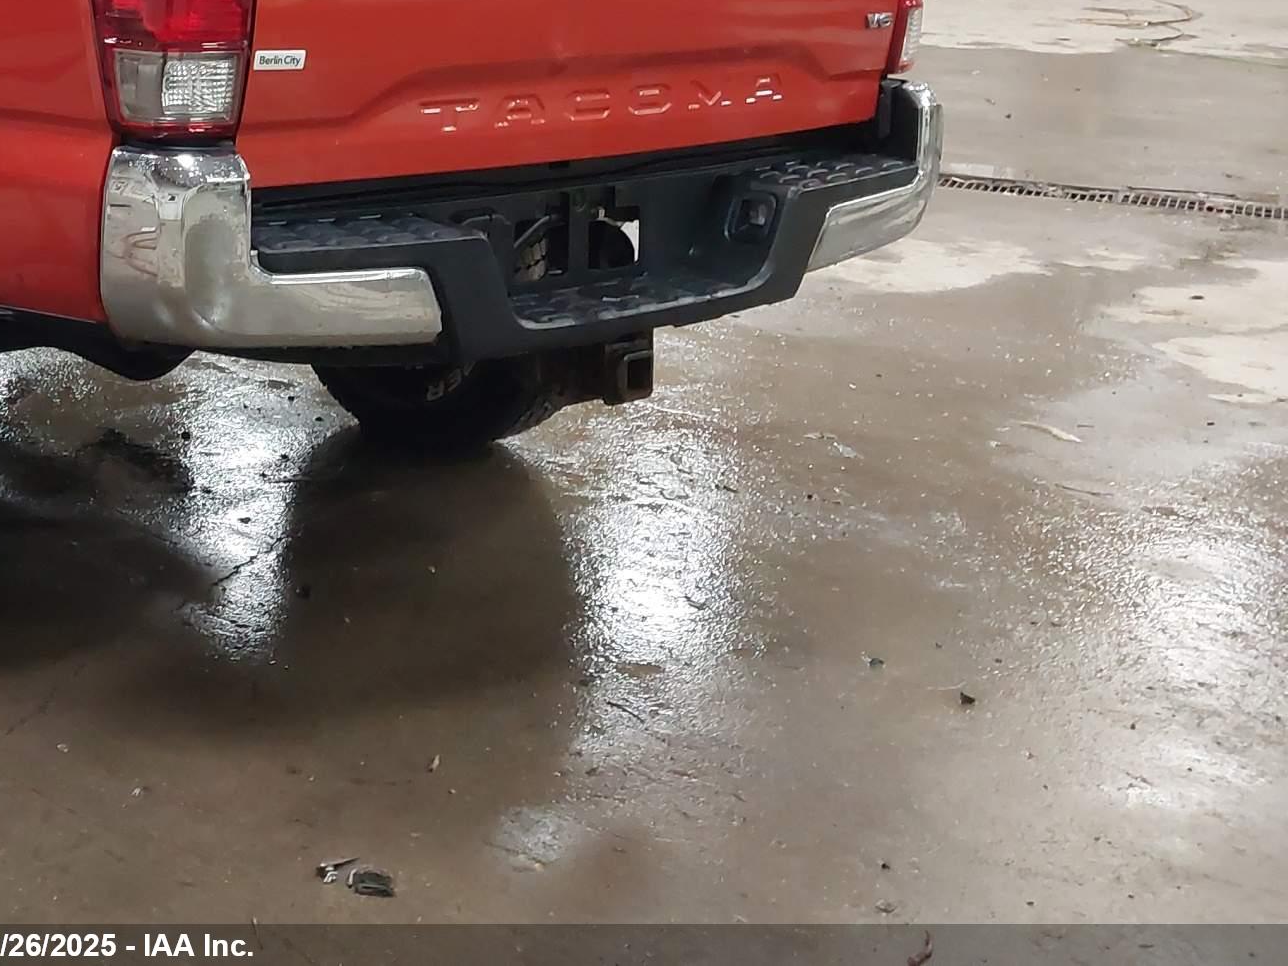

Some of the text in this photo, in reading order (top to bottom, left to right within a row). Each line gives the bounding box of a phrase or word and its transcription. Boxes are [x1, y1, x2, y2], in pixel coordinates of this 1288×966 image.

[259, 55, 301, 67] Berlin City
[419, 74, 783, 131] TACOMA
